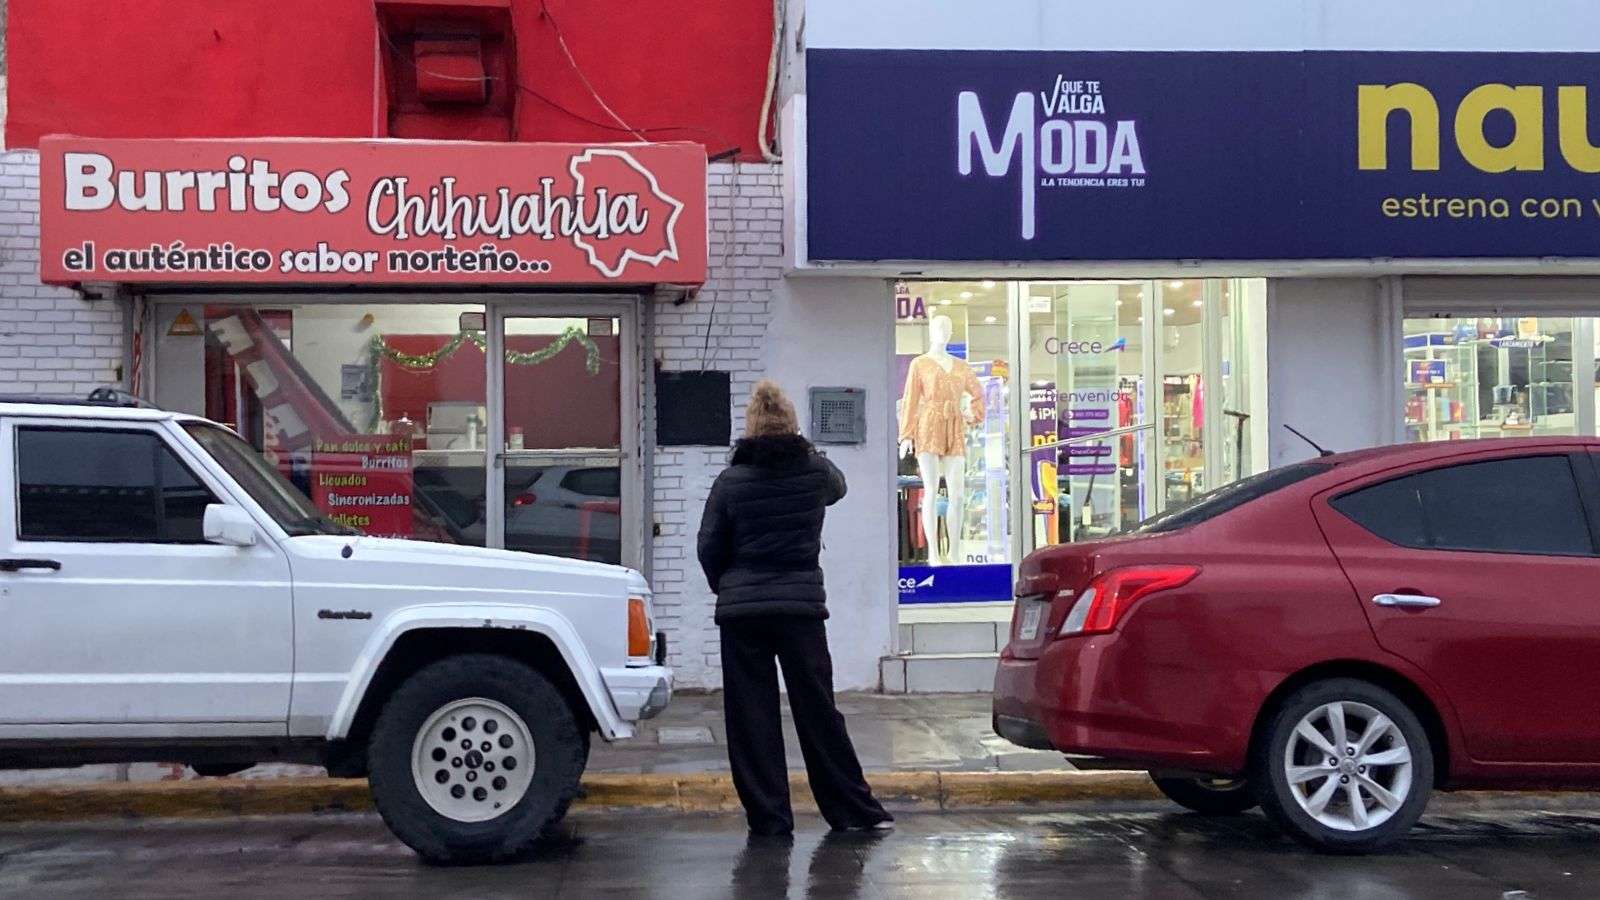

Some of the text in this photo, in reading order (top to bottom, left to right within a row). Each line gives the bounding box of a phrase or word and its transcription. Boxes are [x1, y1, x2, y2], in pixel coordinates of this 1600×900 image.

[1040, 74, 1106, 117] VALGA
[1061, 81, 1101, 95] QUE TE
[957, 90, 1147, 240] MODA
[1057, 178, 1105, 187] TENDENCIA
[1107, 179, 1129, 187] ERES
[63, 152, 649, 241] Burritos Chihuahua
[1381, 193, 1511, 218] estrena
[1520, 197, 1583, 218] con
[62, 240, 552, 274] el auténtico sabor norteño...
[1044, 337, 1103, 355] Crece
[361, 456, 408, 470] Burritos
[319, 473, 367, 486] Licuados
[328, 492, 410, 505] Sincronizadas
